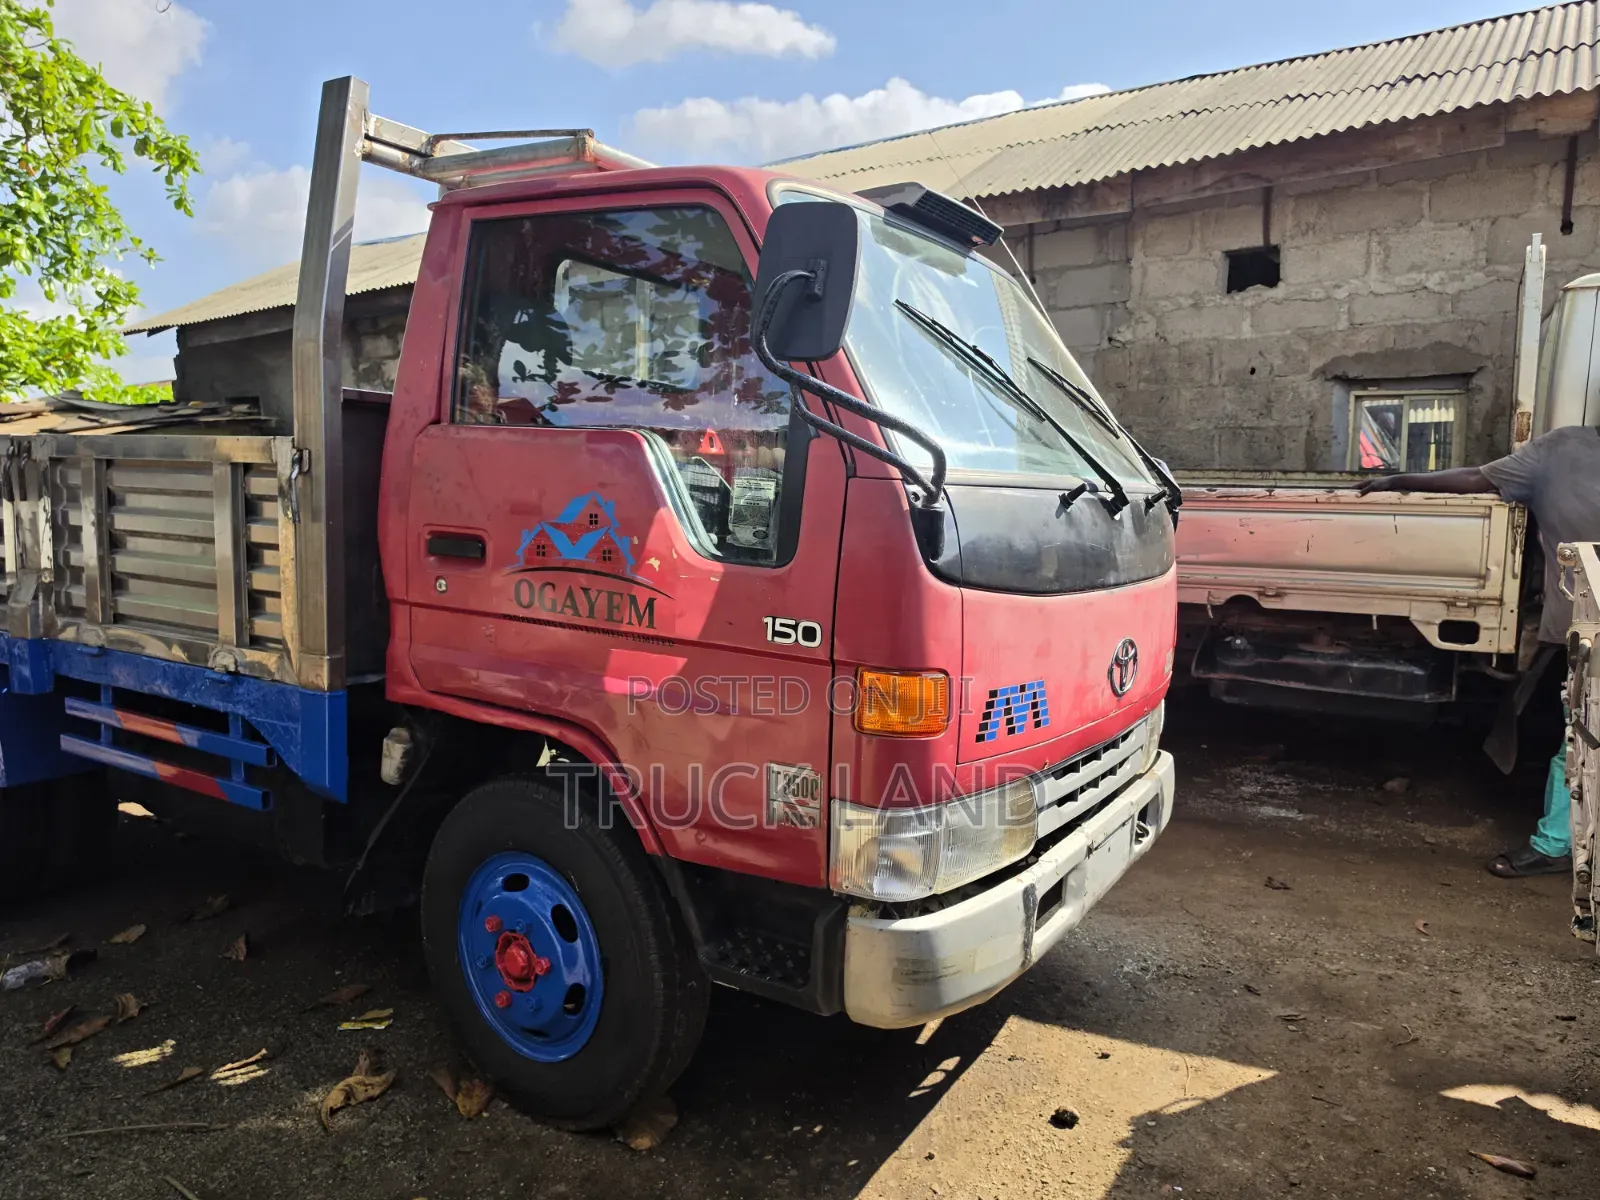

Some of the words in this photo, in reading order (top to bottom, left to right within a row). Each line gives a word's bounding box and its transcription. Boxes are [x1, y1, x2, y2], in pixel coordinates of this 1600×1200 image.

[514, 578, 657, 630] OGAYEM
[632, 633, 677, 648] LIMITED
[763, 616, 822, 648] 150
